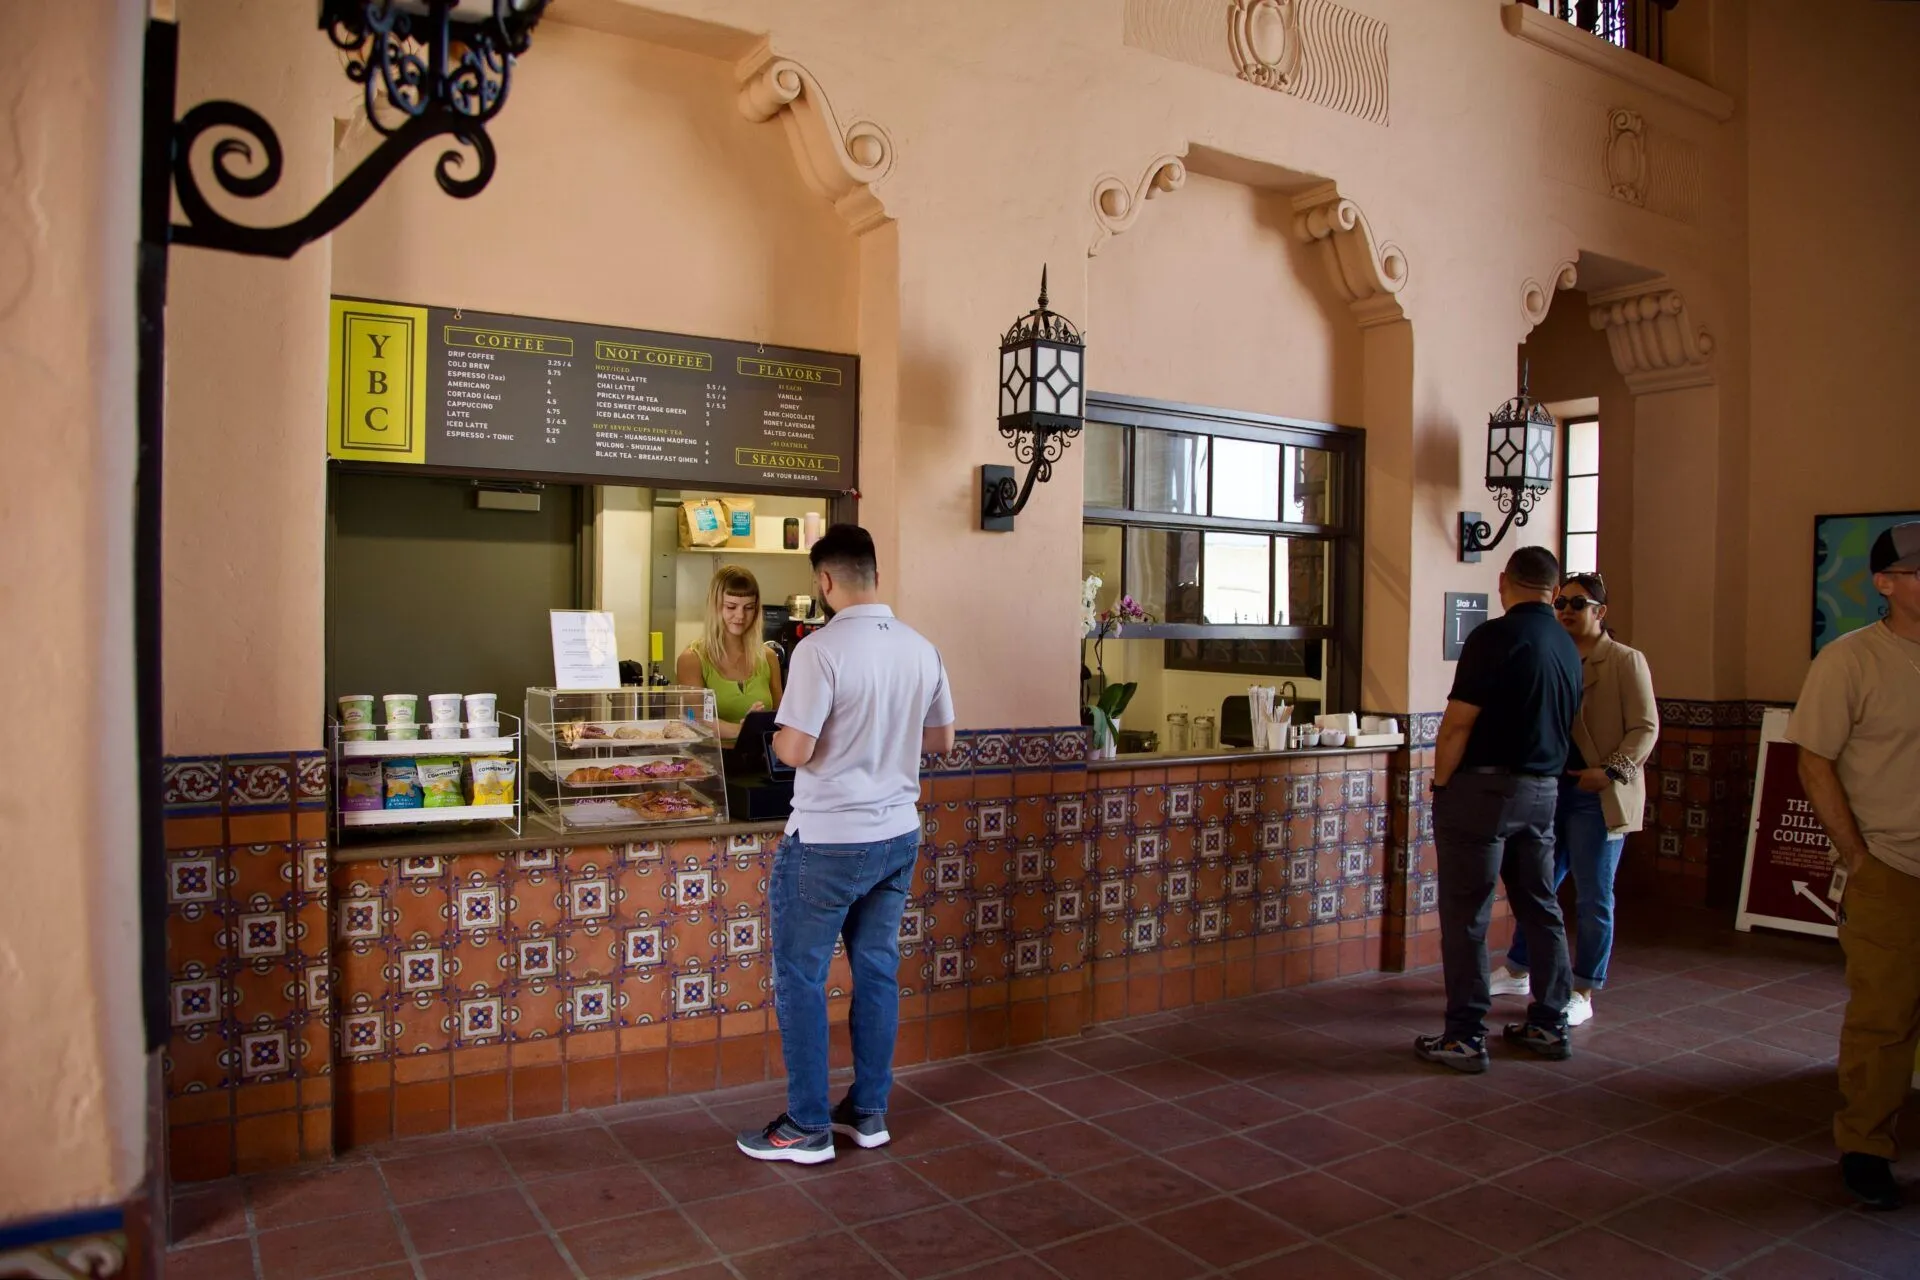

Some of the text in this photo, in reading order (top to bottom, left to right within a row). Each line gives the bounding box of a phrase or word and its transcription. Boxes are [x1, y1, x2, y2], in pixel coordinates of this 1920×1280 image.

[475, 334, 545, 351] COFFEE
[448, 350, 465, 358] DRIP
[467, 352, 495, 360] COFFEE
[605, 347, 703, 367] NOT COFFEE
[595, 364, 630, 373] HOT/ICED
[759, 364, 822, 381] FLAVORS
[448, 371, 486, 379] ESPRESSO
[597, 373, 625, 381] MATCHA
[447, 381, 490, 389] AMERICANO
[447, 391, 481, 399] CORTADO
[597, 392, 625, 400] PRICKLY
[778, 393, 803, 401] VANILLA
[447, 401, 493, 409] CAPPUCCINO
[613, 403, 636, 411] SWEET
[638, 405, 664, 413] ORANGE
[666, 407, 686, 415] GREEN
[782, 412, 815, 421] CHOCOLATE
[785, 421, 815, 429] LAVENDAR
[446, 431, 484, 439] ESPRESSO
[624, 434, 665, 442] HUANGSHAN
[667, 437, 697, 445] MAOFENG
[787, 431, 815, 439] CARAMEL
[596, 441, 624, 449] WULONG
[631, 443, 662, 451] SHUIXIAN
[638, 454, 676, 462] BREAKFAST
[752, 453, 825, 469] SEASONAL
[1456, 599, 1477, 608] Stair A
[1787, 798, 1814, 813] TH
